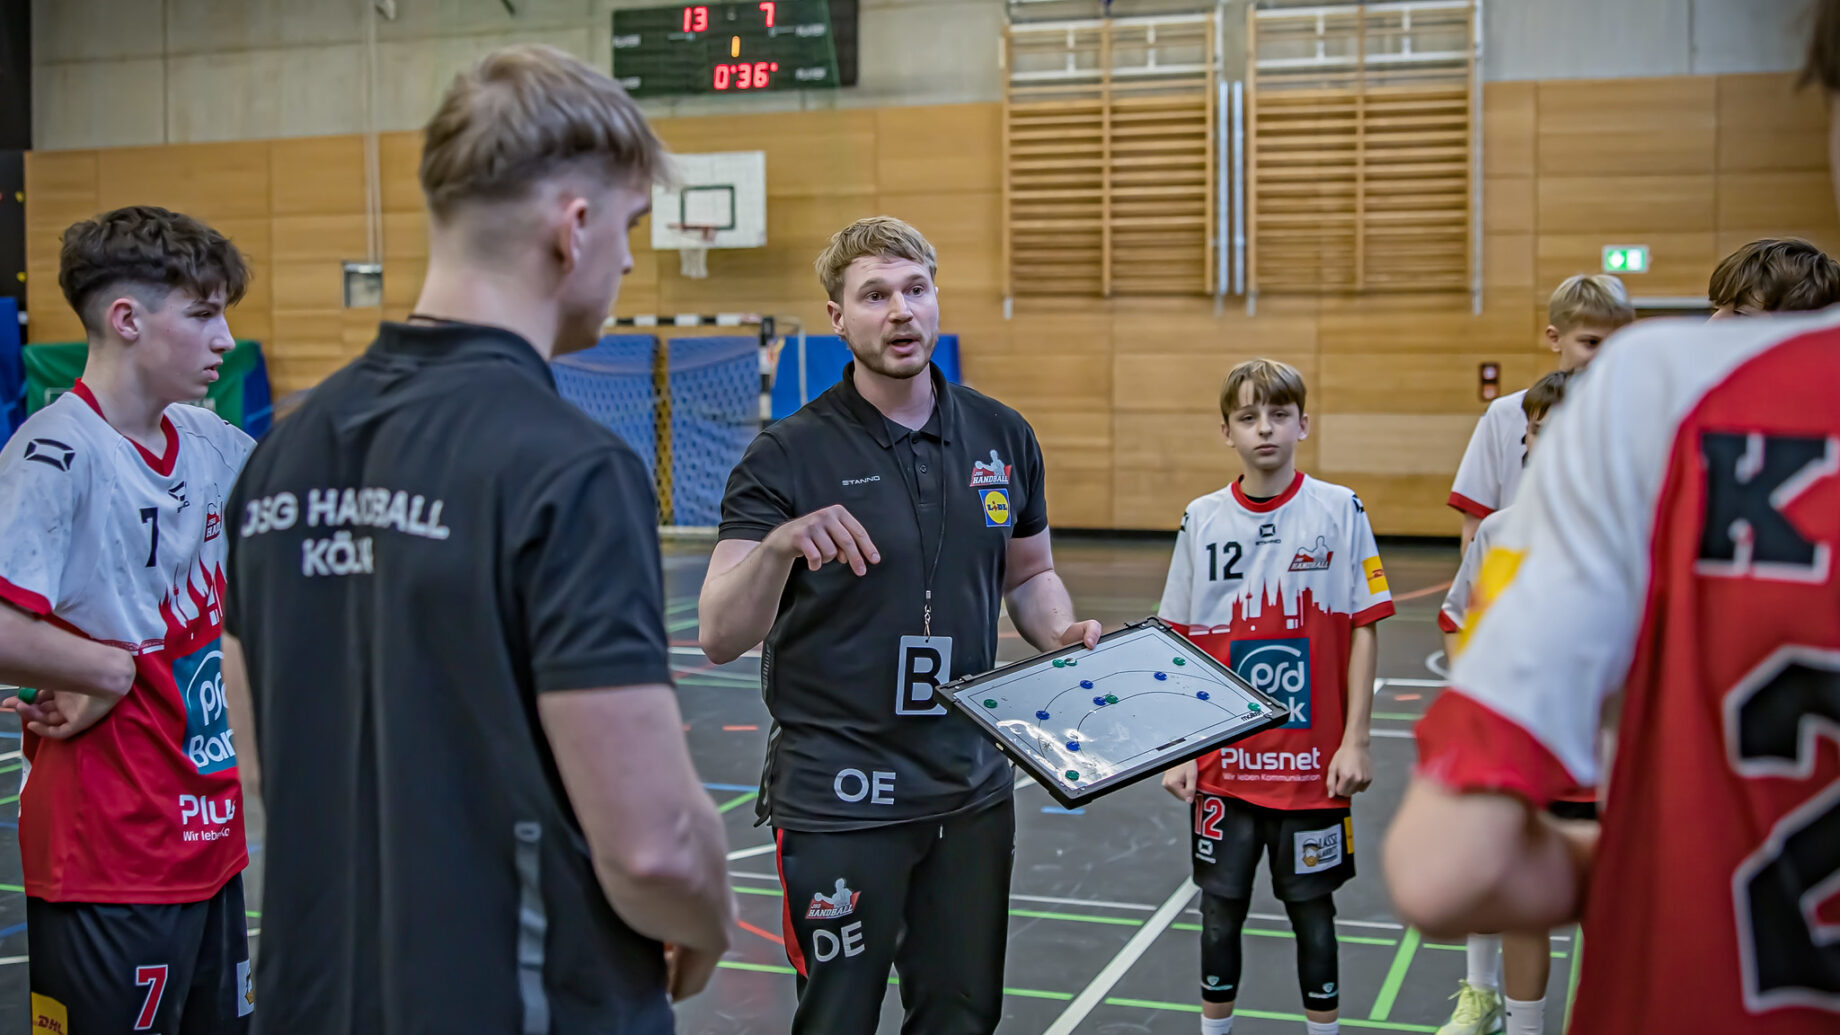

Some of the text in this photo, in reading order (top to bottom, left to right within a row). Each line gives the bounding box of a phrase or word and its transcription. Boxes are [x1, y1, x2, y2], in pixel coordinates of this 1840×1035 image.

[683, 6, 709, 32] 13
[759, 2, 776, 28] 7
[842, 475, 881, 486] STANNO
[973, 476, 1009, 485] HANDBALL
[139, 507, 159, 568] 7
[1206, 541, 1244, 582] 12
[903, 646, 942, 711] B
[1251, 661, 1305, 692] psd
[1220, 746, 1321, 771] Plusnet
[834, 768, 897, 805] OE
[1194, 793, 1226, 841] 12
[183, 830, 200, 841] Wir
[808, 904, 853, 917] HANDBALL
[812, 920, 866, 963] OE
[134, 964, 169, 1030] 7
